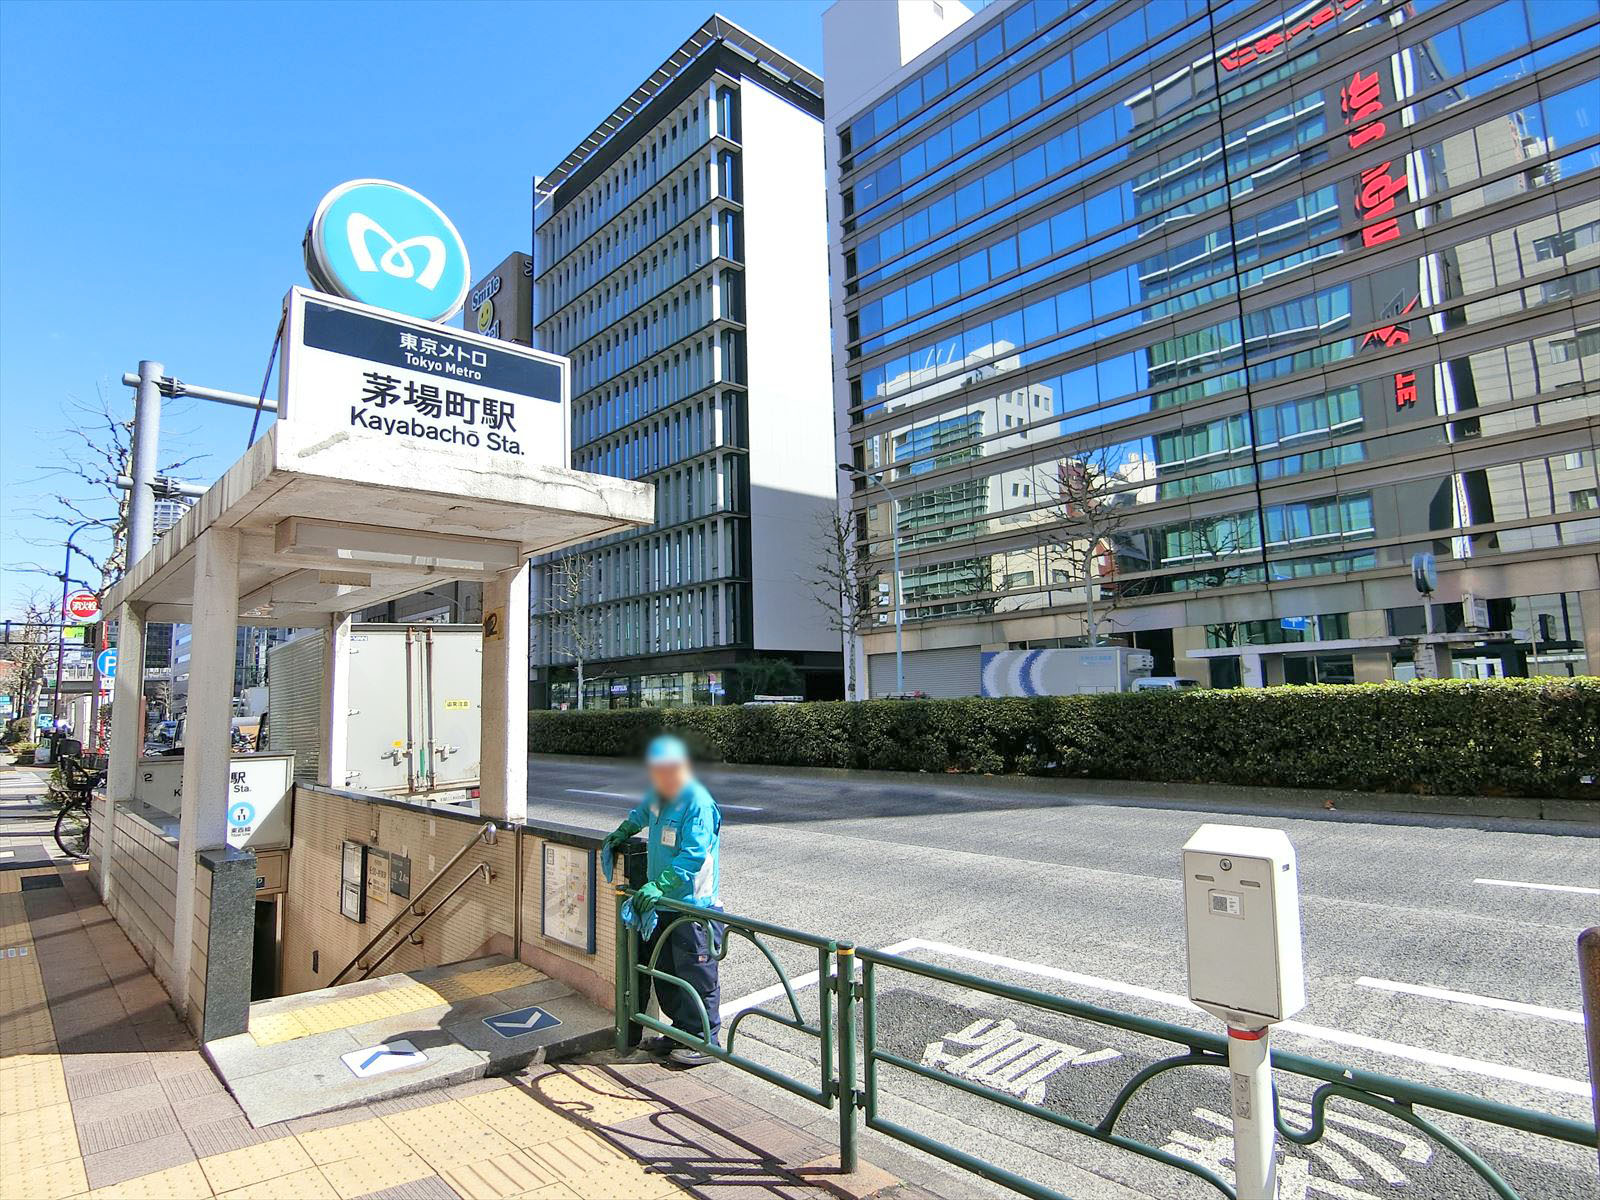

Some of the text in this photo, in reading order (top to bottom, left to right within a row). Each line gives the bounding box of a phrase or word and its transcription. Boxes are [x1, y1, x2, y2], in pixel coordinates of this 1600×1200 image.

[472, 275, 501, 311] Smile
[400, 332, 487, 367] 東京メトロ
[404, 352, 482, 381] Tokyo Metro
[361, 372, 517, 433] 茅場町駅
[350, 405, 525, 456] Kayabachō Sta.
[72, 601, 97, 610] 消火栓
[484, 613, 498, 637] 2
[143, 773, 153, 782] 2
[233, 785, 252, 793] Sta.
